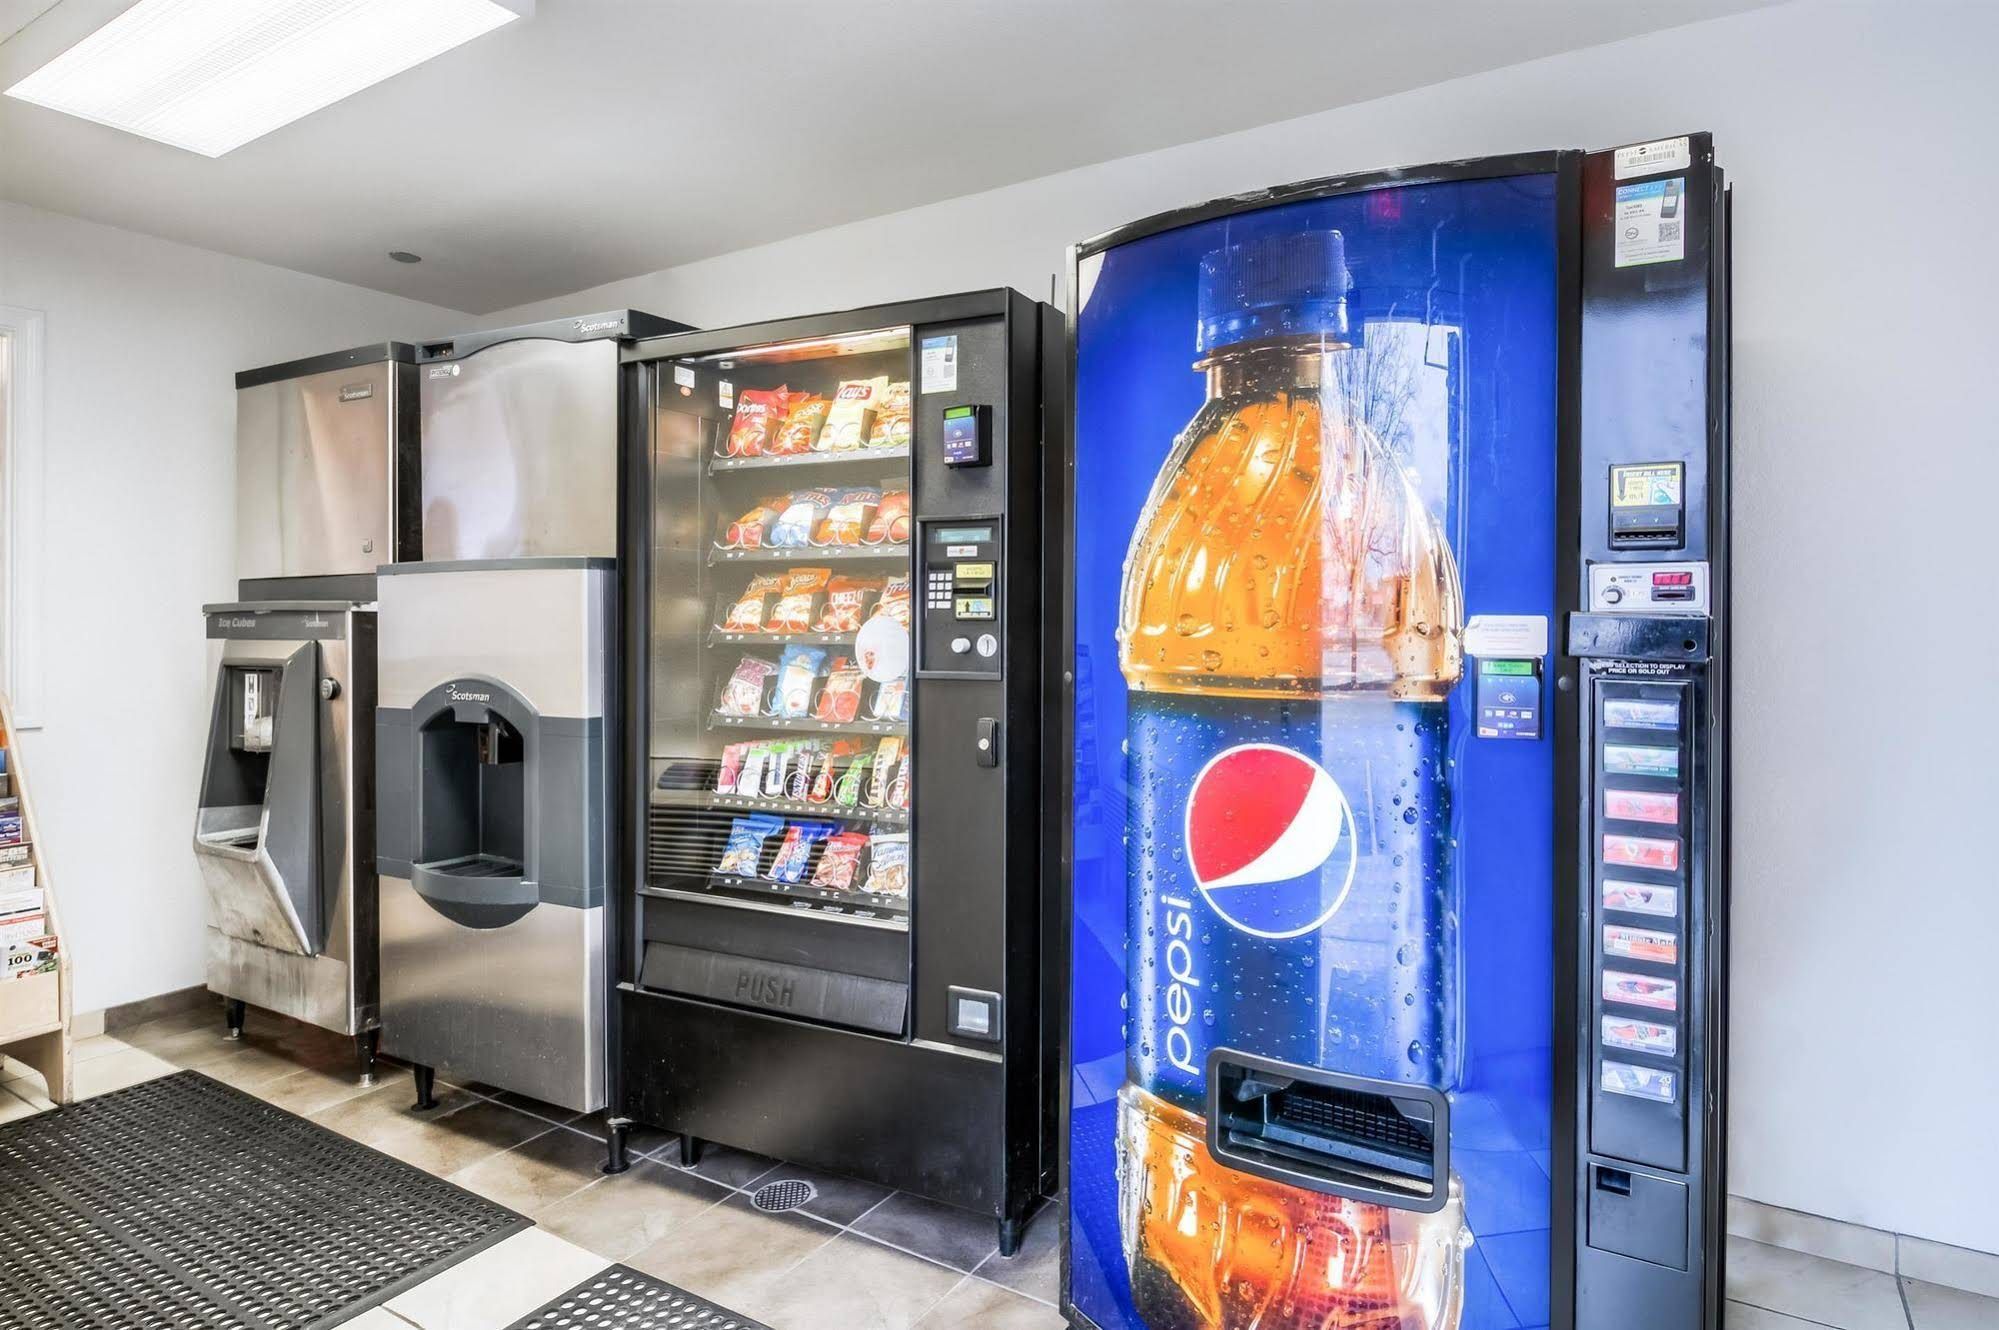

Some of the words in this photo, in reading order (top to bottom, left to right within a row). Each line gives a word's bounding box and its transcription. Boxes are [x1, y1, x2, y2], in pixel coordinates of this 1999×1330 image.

[580, 321, 619, 333] Scotsman
[232, 618, 256, 628] Cubes
[451, 690, 490, 702] Scotsman
[8, 954, 33, 966] 100
[735, 968, 796, 1008] PUSH
[1161, 895, 1200, 1076] pepsi
